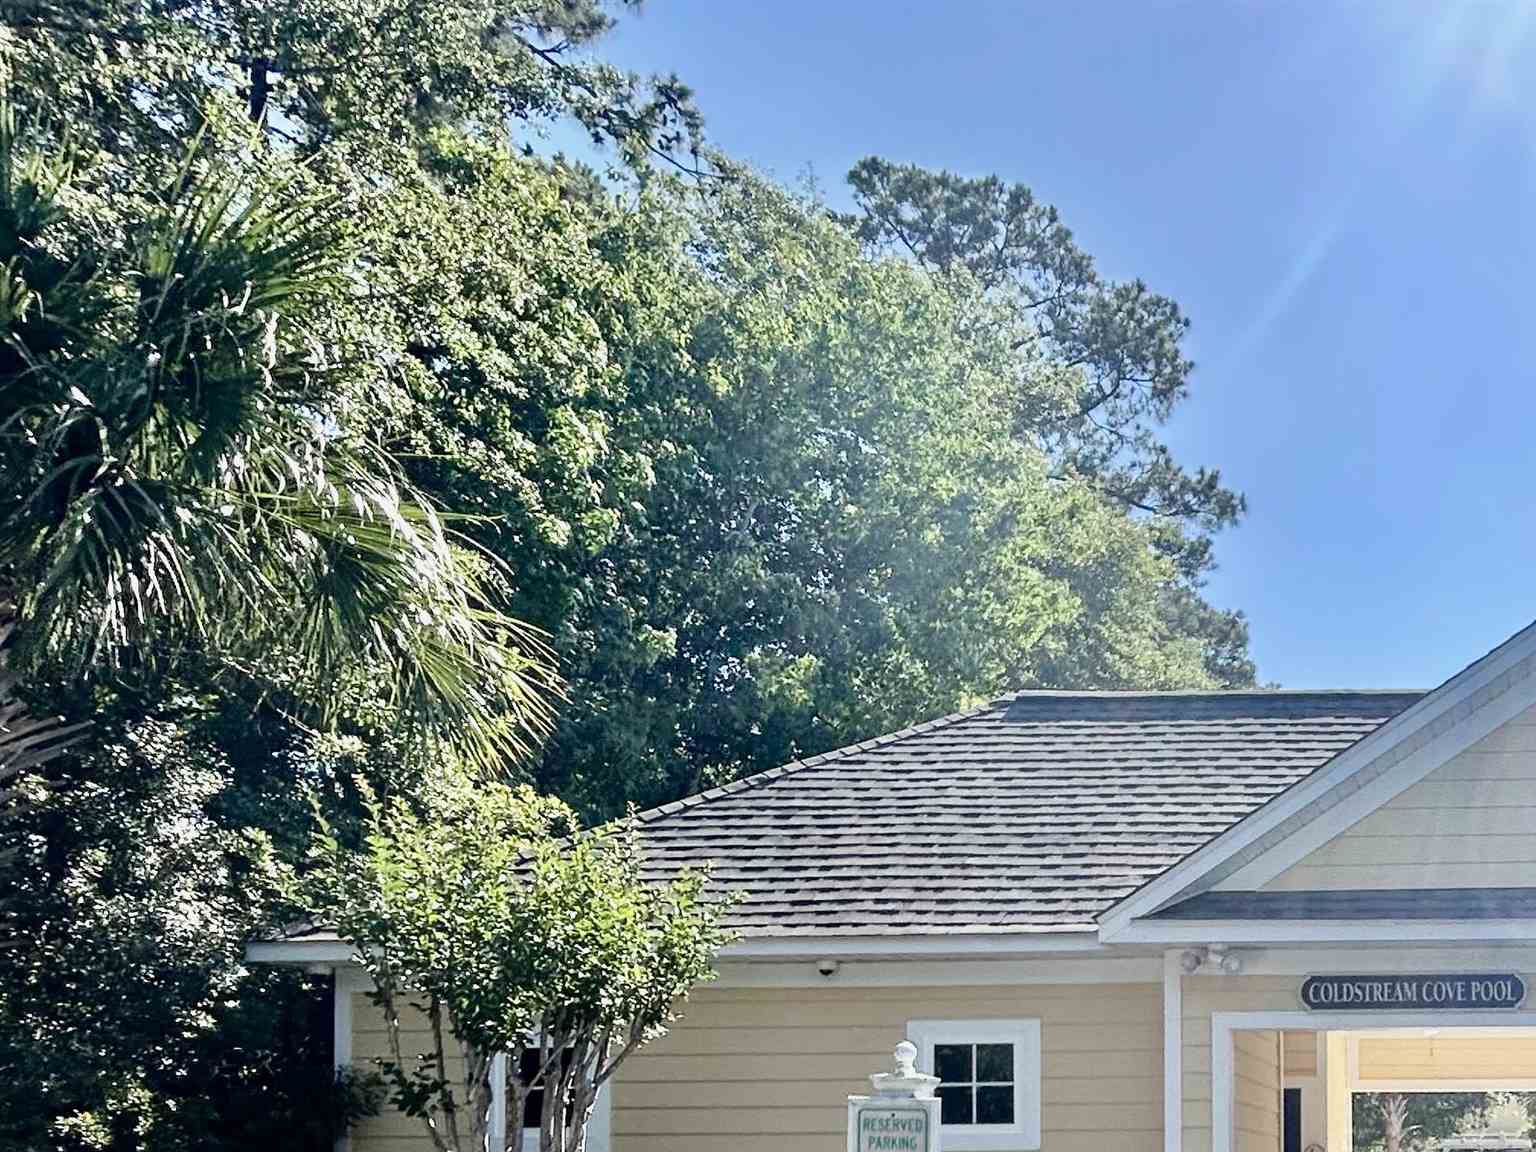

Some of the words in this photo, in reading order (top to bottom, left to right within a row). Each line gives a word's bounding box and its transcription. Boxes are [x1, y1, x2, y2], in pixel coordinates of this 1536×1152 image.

[1309, 982, 1417, 1002] COLDSTREAM
[1422, 981, 1466, 1001] COVE
[1471, 980, 1516, 1001] POOL
[863, 1119, 923, 1132] RESERVED
[868, 1136, 918, 1150] PARKING
